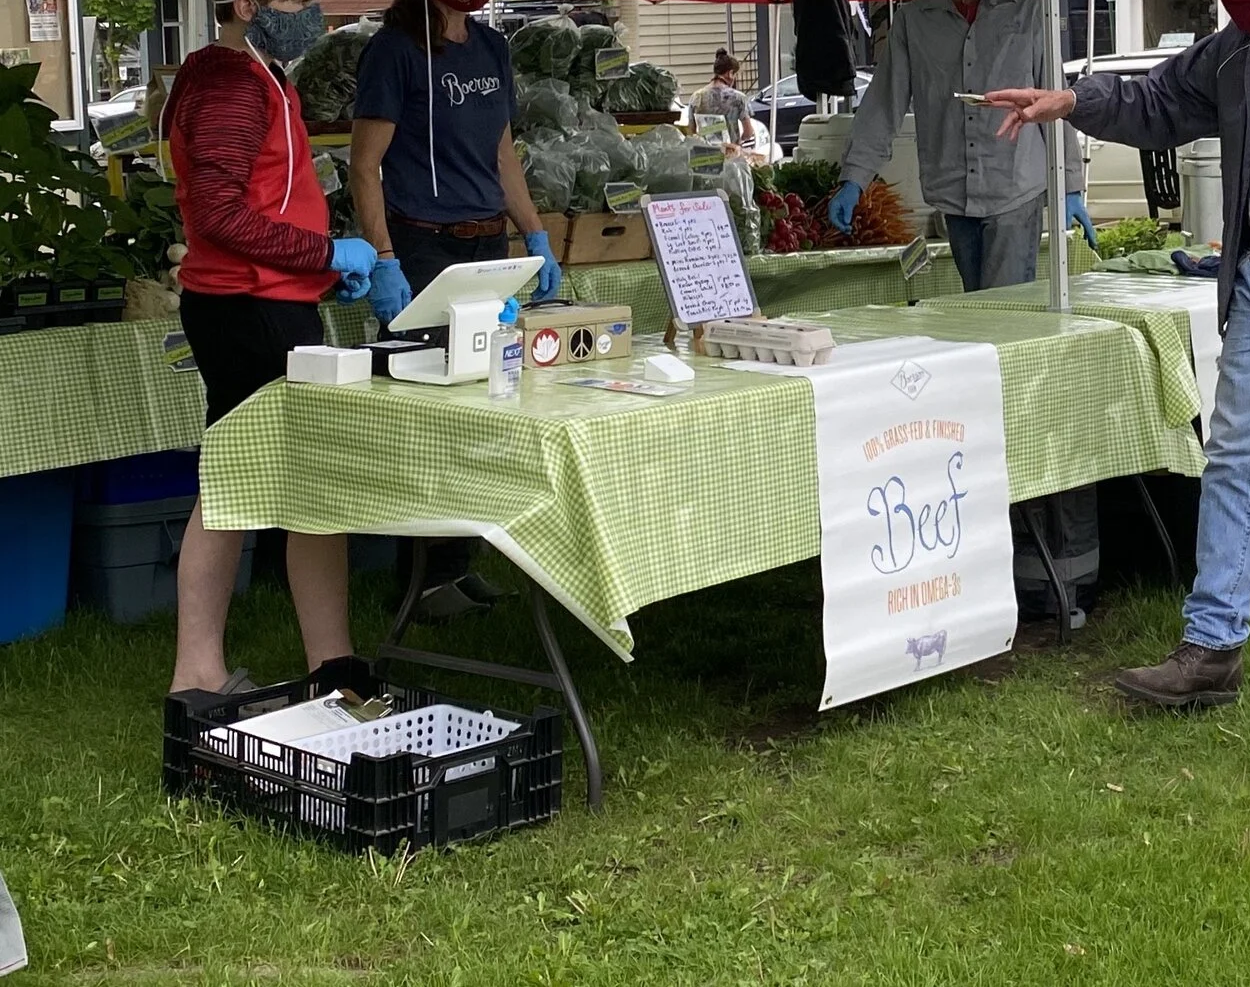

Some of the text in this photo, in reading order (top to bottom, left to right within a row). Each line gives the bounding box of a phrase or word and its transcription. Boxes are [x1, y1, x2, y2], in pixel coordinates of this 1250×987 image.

[441, 72, 500, 107] Boerson
[862, 419, 965, 462] 100% GRASS-FED & FINISHED
[867, 451, 969, 575] Beef
[887, 586, 908, 615] RICH
[910, 582, 920, 609] IN
